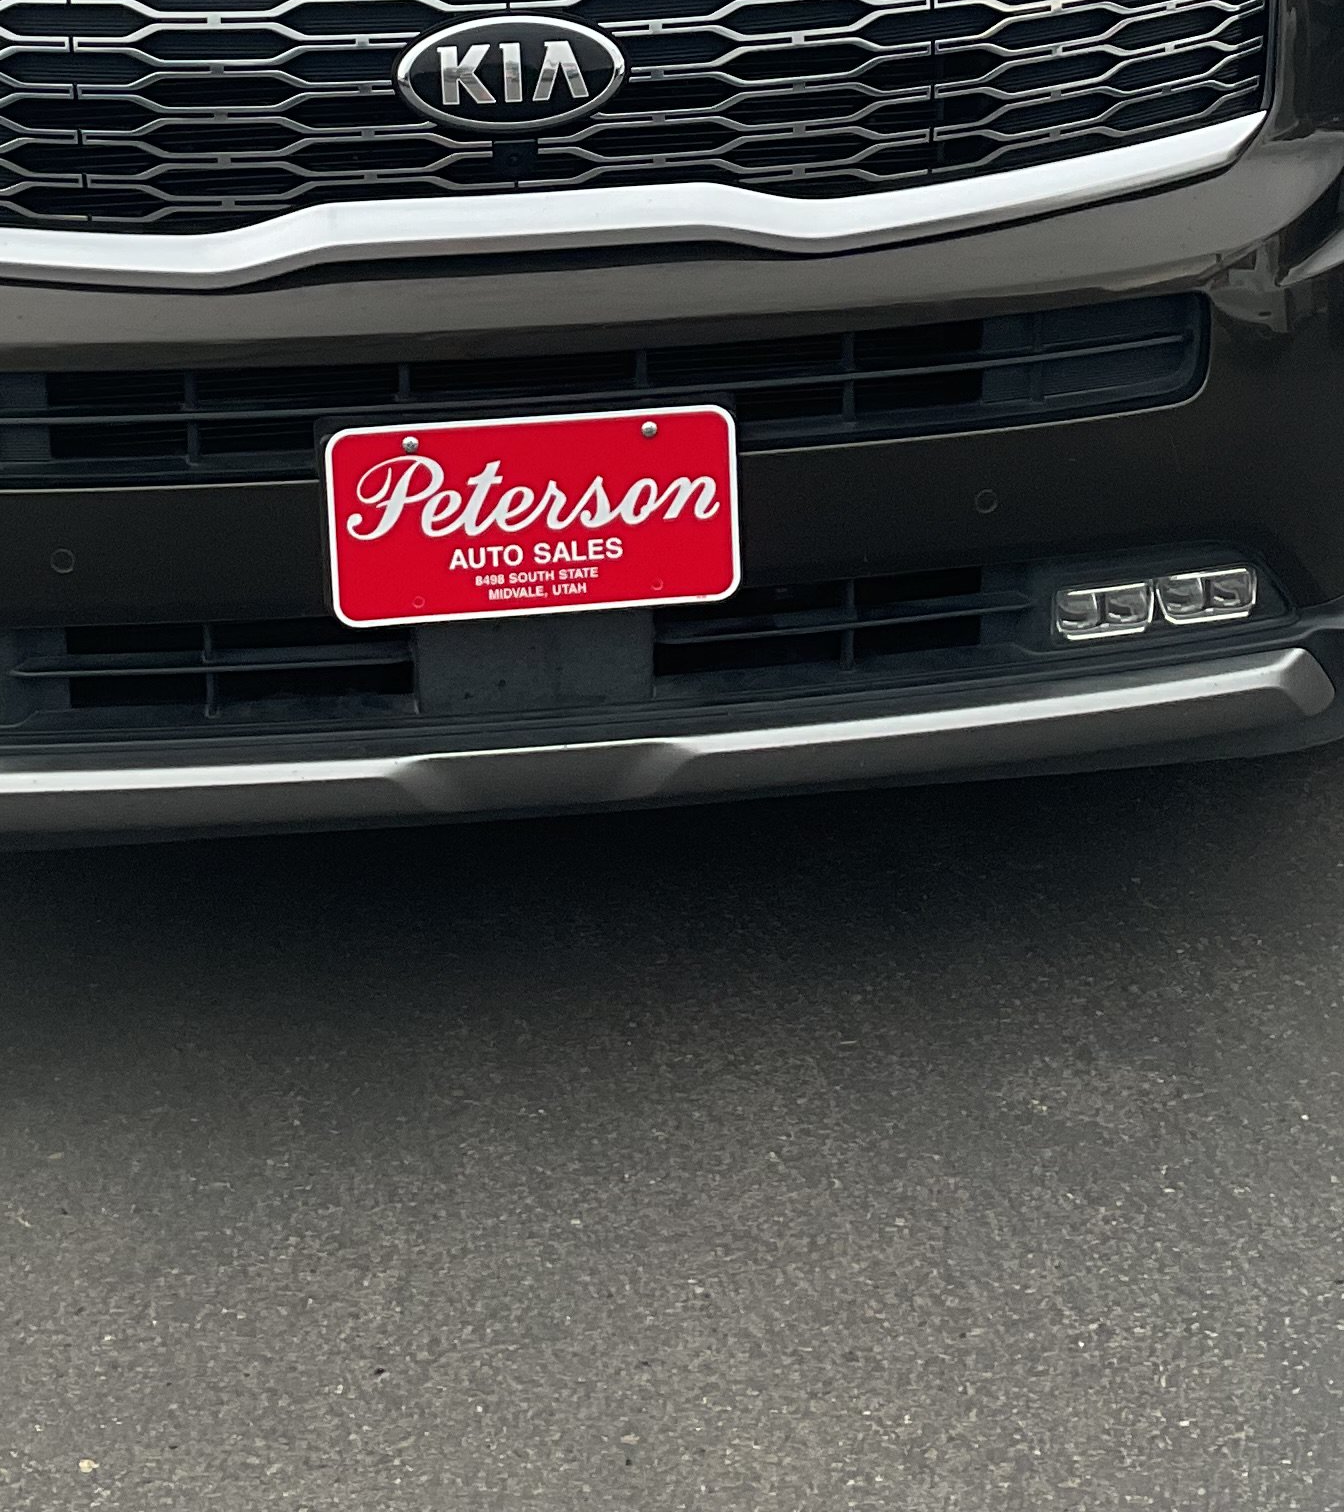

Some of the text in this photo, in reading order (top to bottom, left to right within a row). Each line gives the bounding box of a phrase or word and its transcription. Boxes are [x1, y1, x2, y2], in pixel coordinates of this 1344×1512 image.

[437, 40, 589, 105] KIA
[346, 454, 721, 541] Peterson
[449, 537, 623, 570] AUTO SALES
[475, 567, 599, 586] 8498 SOUTH STATE
[488, 582, 587, 600] MIDVALE, UTAH
